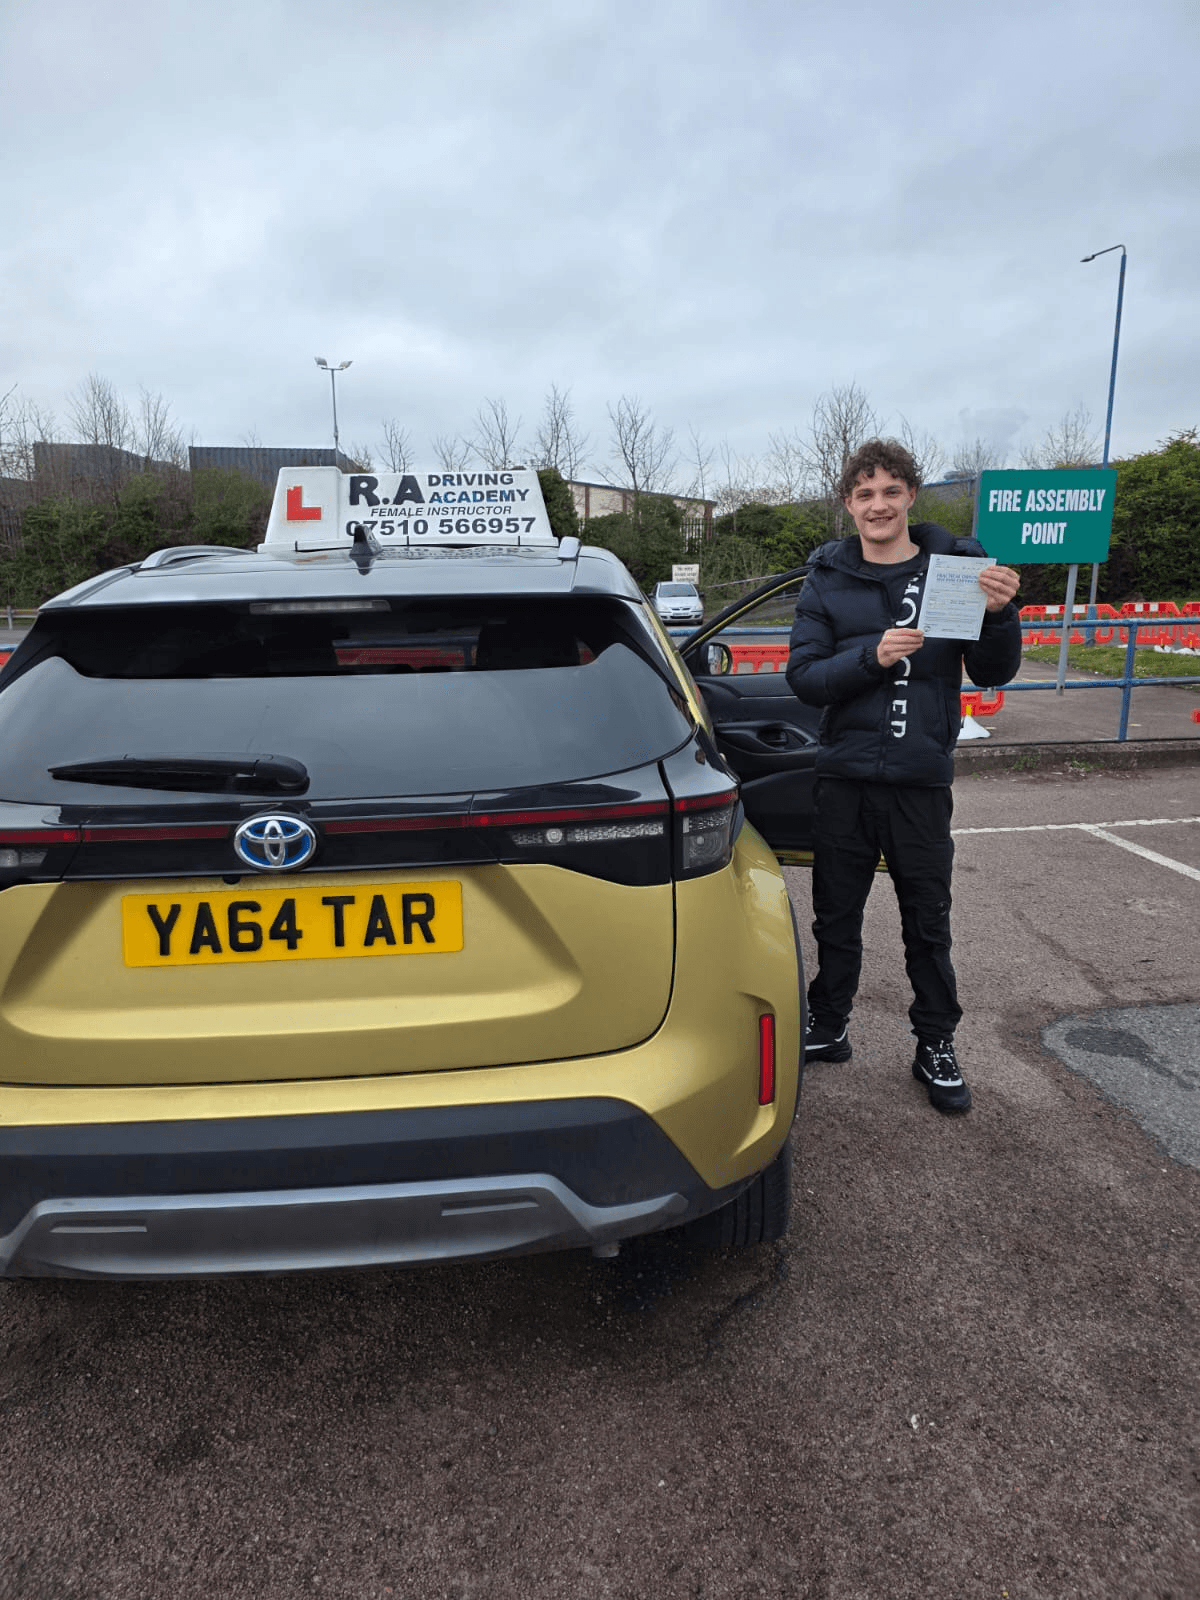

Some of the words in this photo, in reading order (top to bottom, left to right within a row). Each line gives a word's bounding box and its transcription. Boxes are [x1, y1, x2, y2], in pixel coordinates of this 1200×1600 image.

[349, 475, 425, 506] R.A
[428, 473, 514, 487] DRIVING
[429, 488, 530, 504] ACADEMY
[988, 489, 1023, 512] FIRE
[1025, 488, 1107, 512] ASSEMBLY
[286, 485, 322, 521] L
[371, 507, 424, 517] FEMALE
[427, 505, 512, 517] INSTRUCTOR
[438, 517, 536, 535] 566957
[1021, 521, 1067, 545] POINT
[146, 898, 303, 956] YA64
[321, 893, 436, 947] TAR
